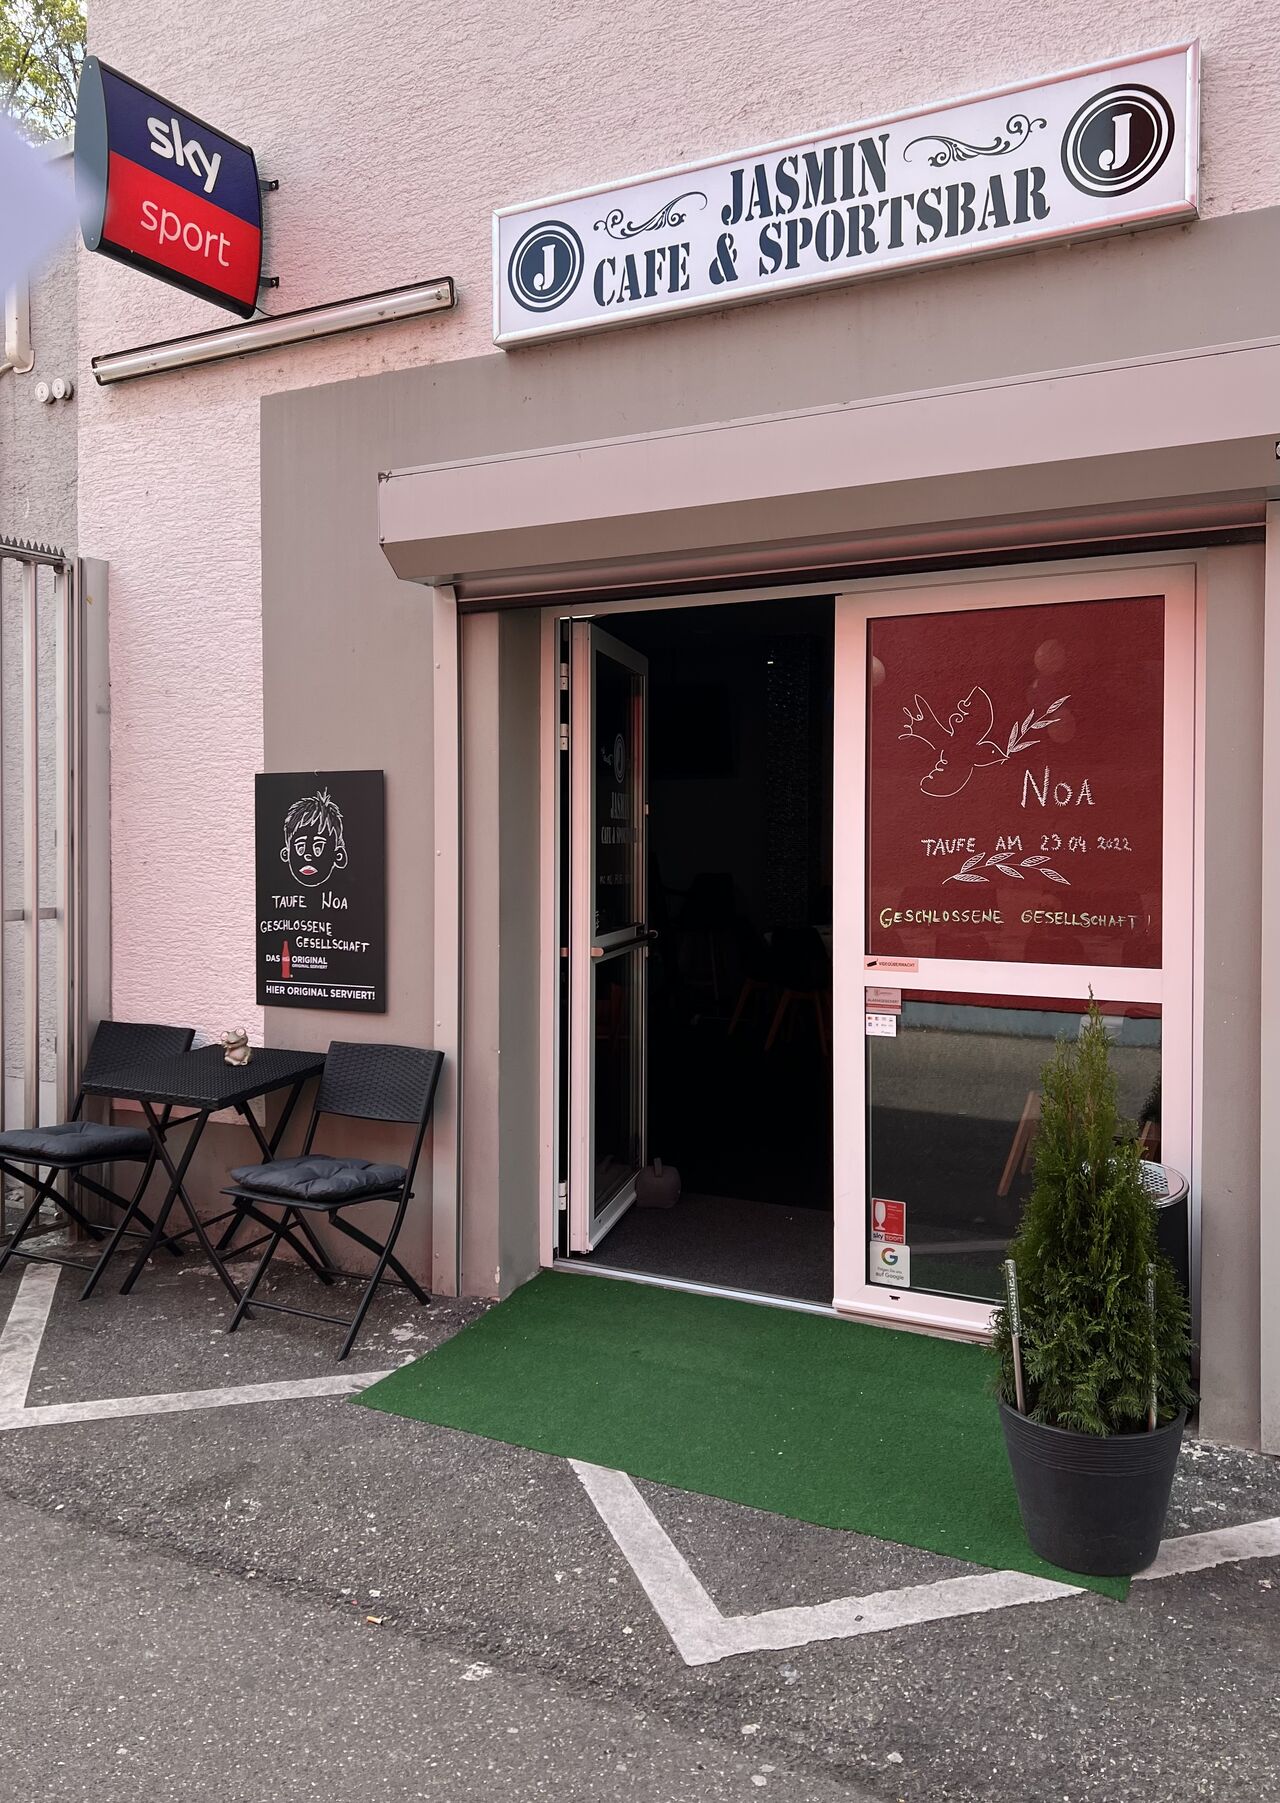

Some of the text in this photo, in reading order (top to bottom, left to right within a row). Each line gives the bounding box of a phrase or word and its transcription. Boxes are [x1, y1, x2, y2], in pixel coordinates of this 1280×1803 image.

[147, 117, 222, 194] sky
[721, 134, 891, 227] JASMIN
[140, 200, 231, 267] sport
[592, 165, 1051, 307] CAFE & SPORTSBAR
[921, 837, 976, 856] TAUFE
[995, 834, 1023, 851] AM
[271, 895, 307, 909] TAUFE
[260, 919, 333, 936] GESCHLOSSENE
[879, 908, 1005, 928] GESCHLOSSENE
[295, 936, 370, 953] GESELLSCHAFT
[265, 954, 280, 962] DAS
[291, 955, 328, 965] ORIGINAL
[265, 985, 376, 1000] HIER ORIGINAL SERVIERT!
